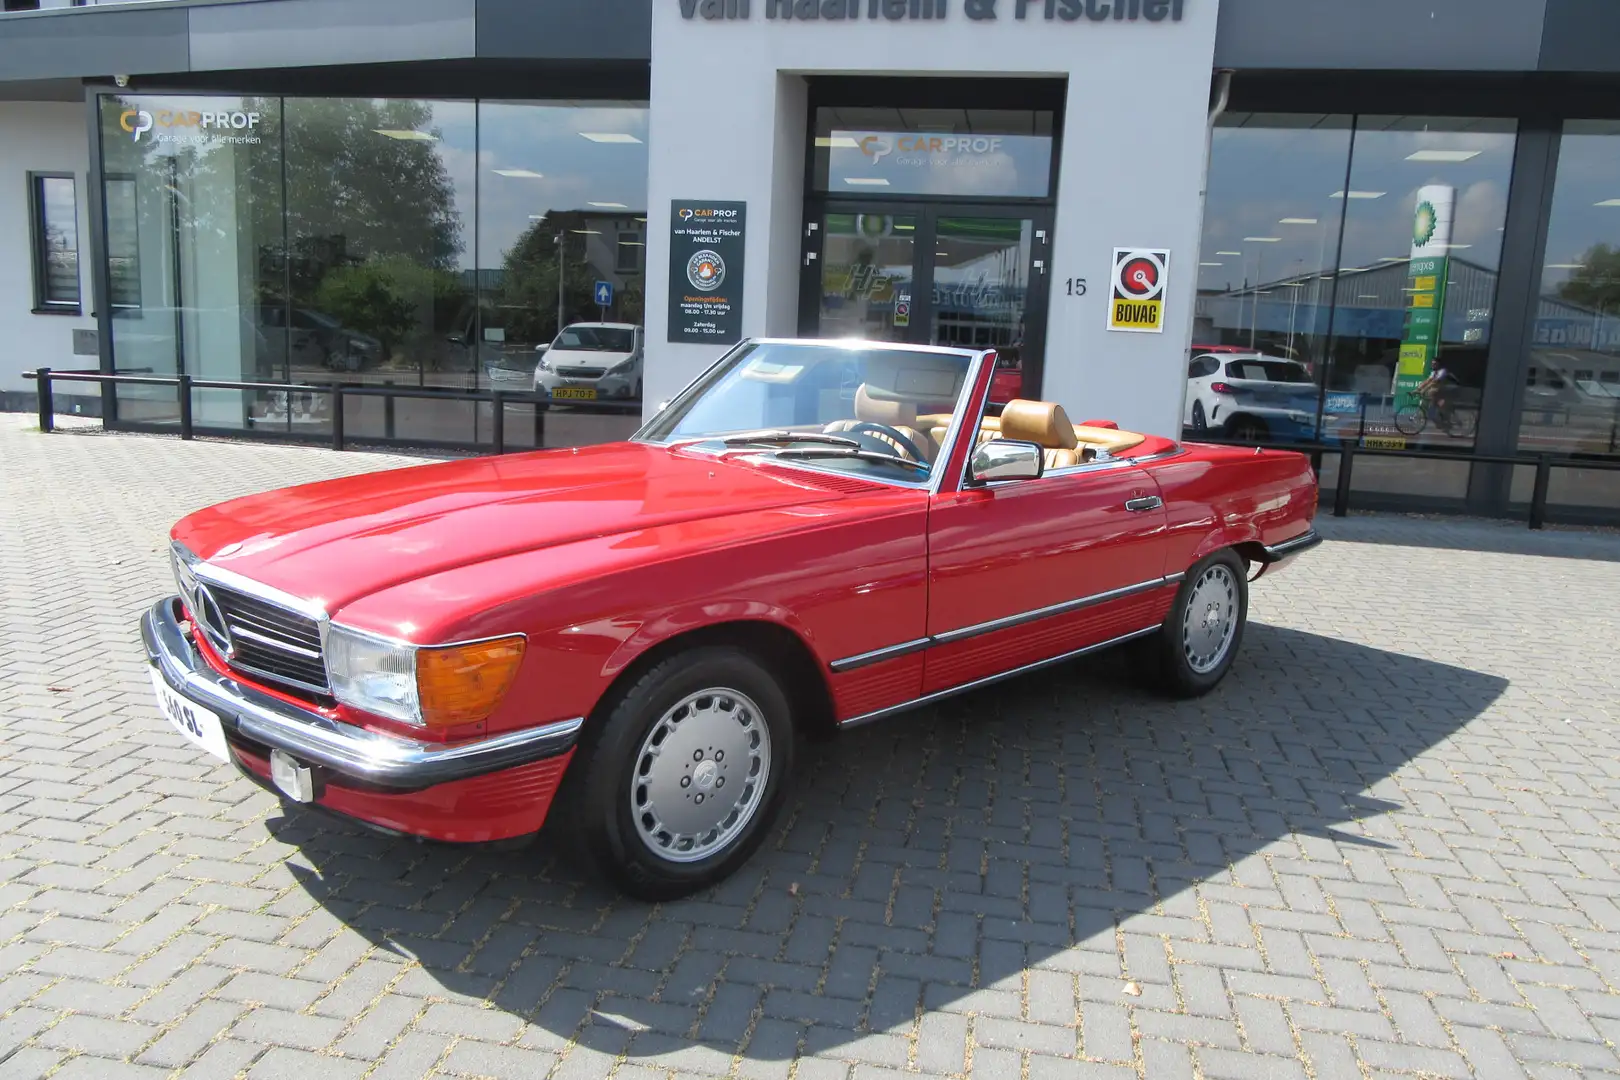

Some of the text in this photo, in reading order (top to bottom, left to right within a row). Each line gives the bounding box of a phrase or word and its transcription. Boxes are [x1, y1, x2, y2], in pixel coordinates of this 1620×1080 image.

[156, 110, 260, 129] CARPROF
[157, 134, 187, 145] Garage
[228, 135, 261, 144] merken
[898, 136, 1002, 153] CARPROF
[694, 209, 737, 217] CARPROF
[1065, 277, 1087, 296] 15
[1115, 304, 1157, 324] BOVAG
[183, 706, 203, 737] SL
